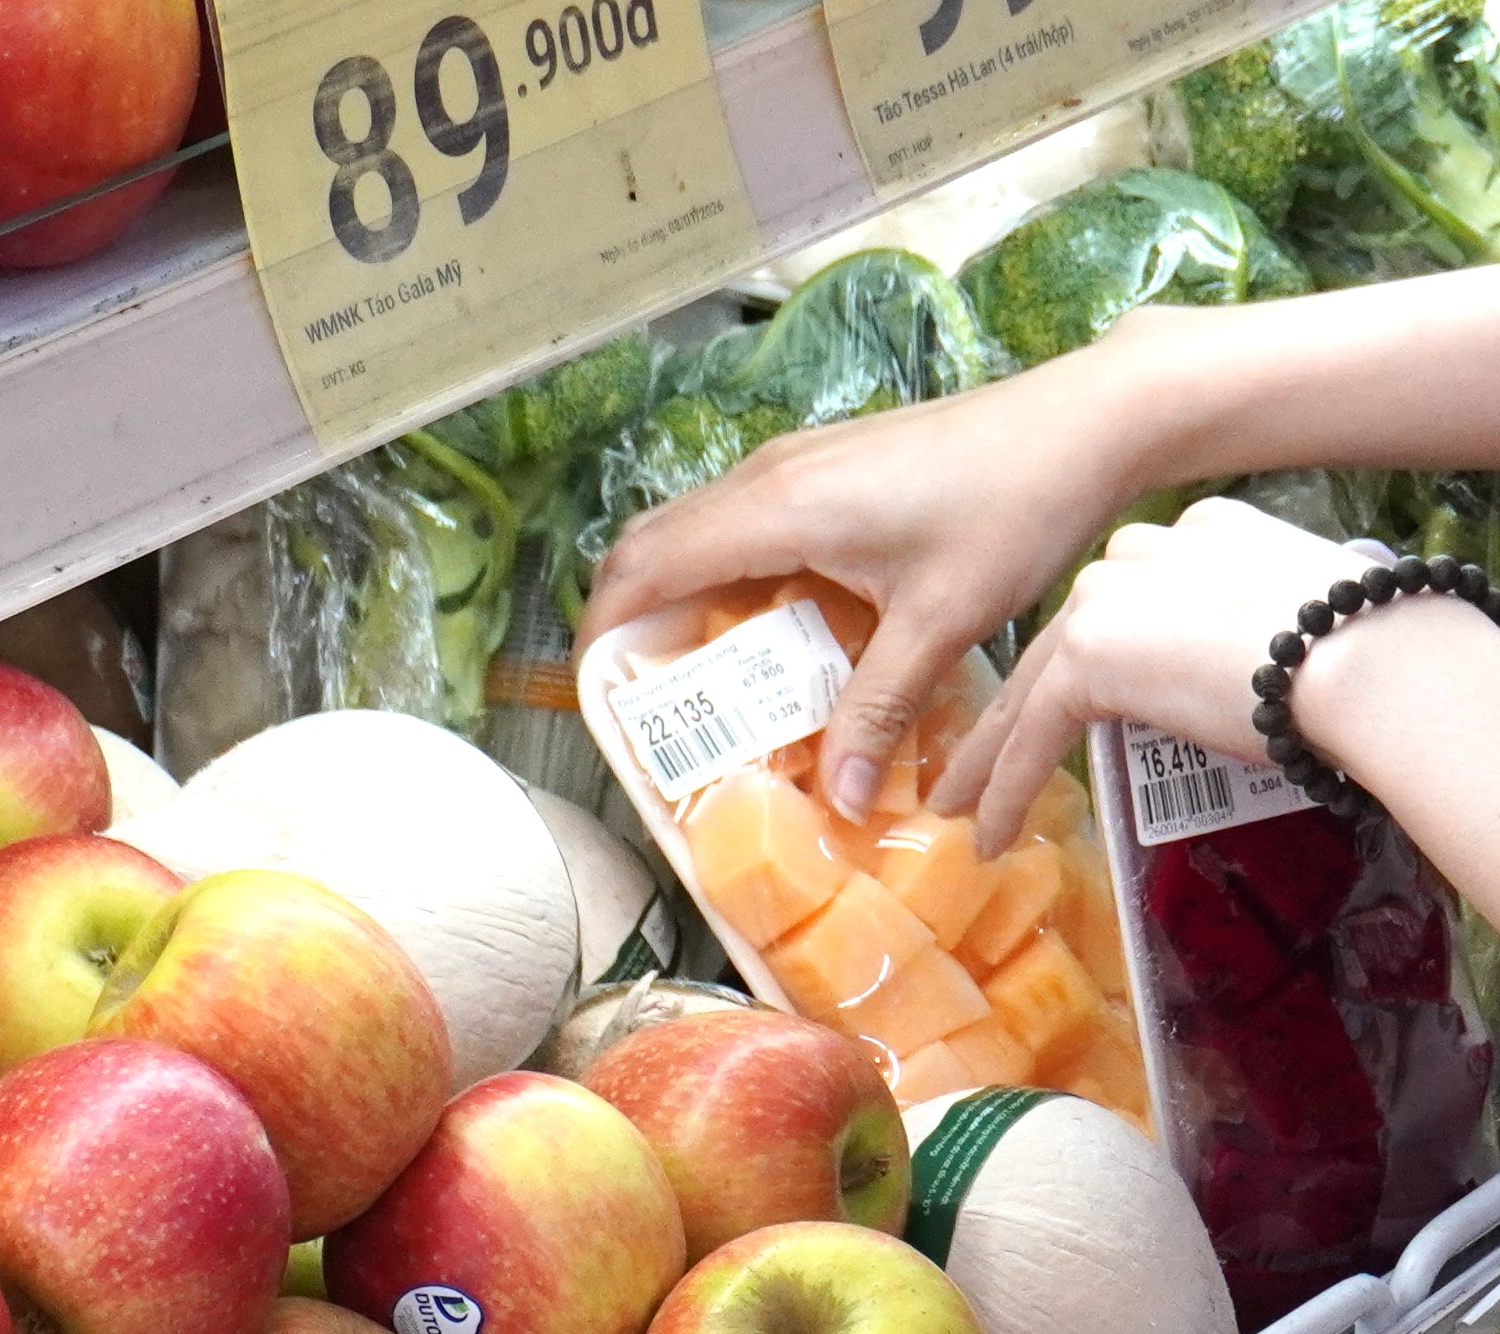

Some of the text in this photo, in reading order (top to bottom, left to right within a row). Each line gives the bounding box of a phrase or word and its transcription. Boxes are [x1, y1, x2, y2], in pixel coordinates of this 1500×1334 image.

[873, 16, 1075, 125] Táo Tessa Hà Lan (4 trái/hộp)
[303, 259, 464, 345] WMNK Táo Gala Mỹ
[349, 359, 367, 381] KG
[639, 690, 716, 747] 22.135
